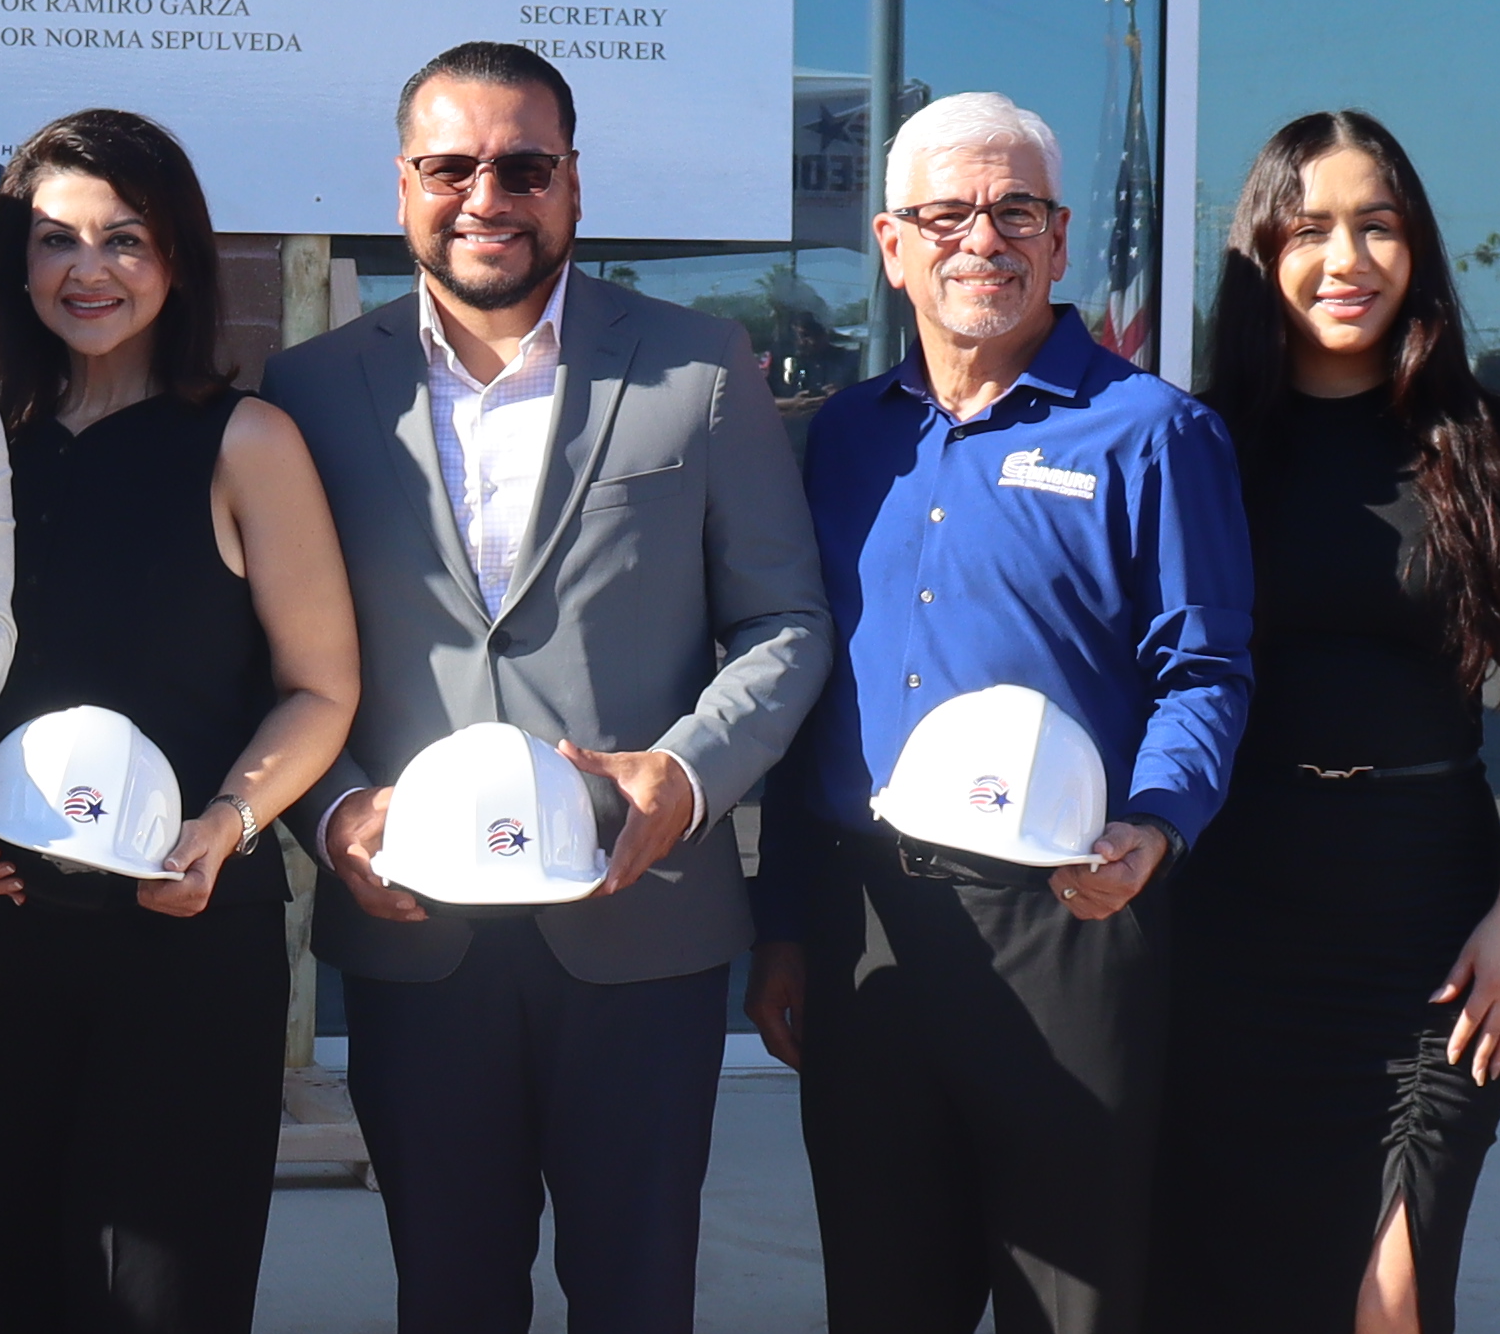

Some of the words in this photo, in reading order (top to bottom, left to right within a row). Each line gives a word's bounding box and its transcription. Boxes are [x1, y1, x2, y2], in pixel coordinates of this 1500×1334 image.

[520, 5, 667, 28] SECRETARY
[45, 28, 144, 49] NORMA
[151, 30, 303, 53] SEPULVEDA
[517, 39, 667, 60] TREASURER
